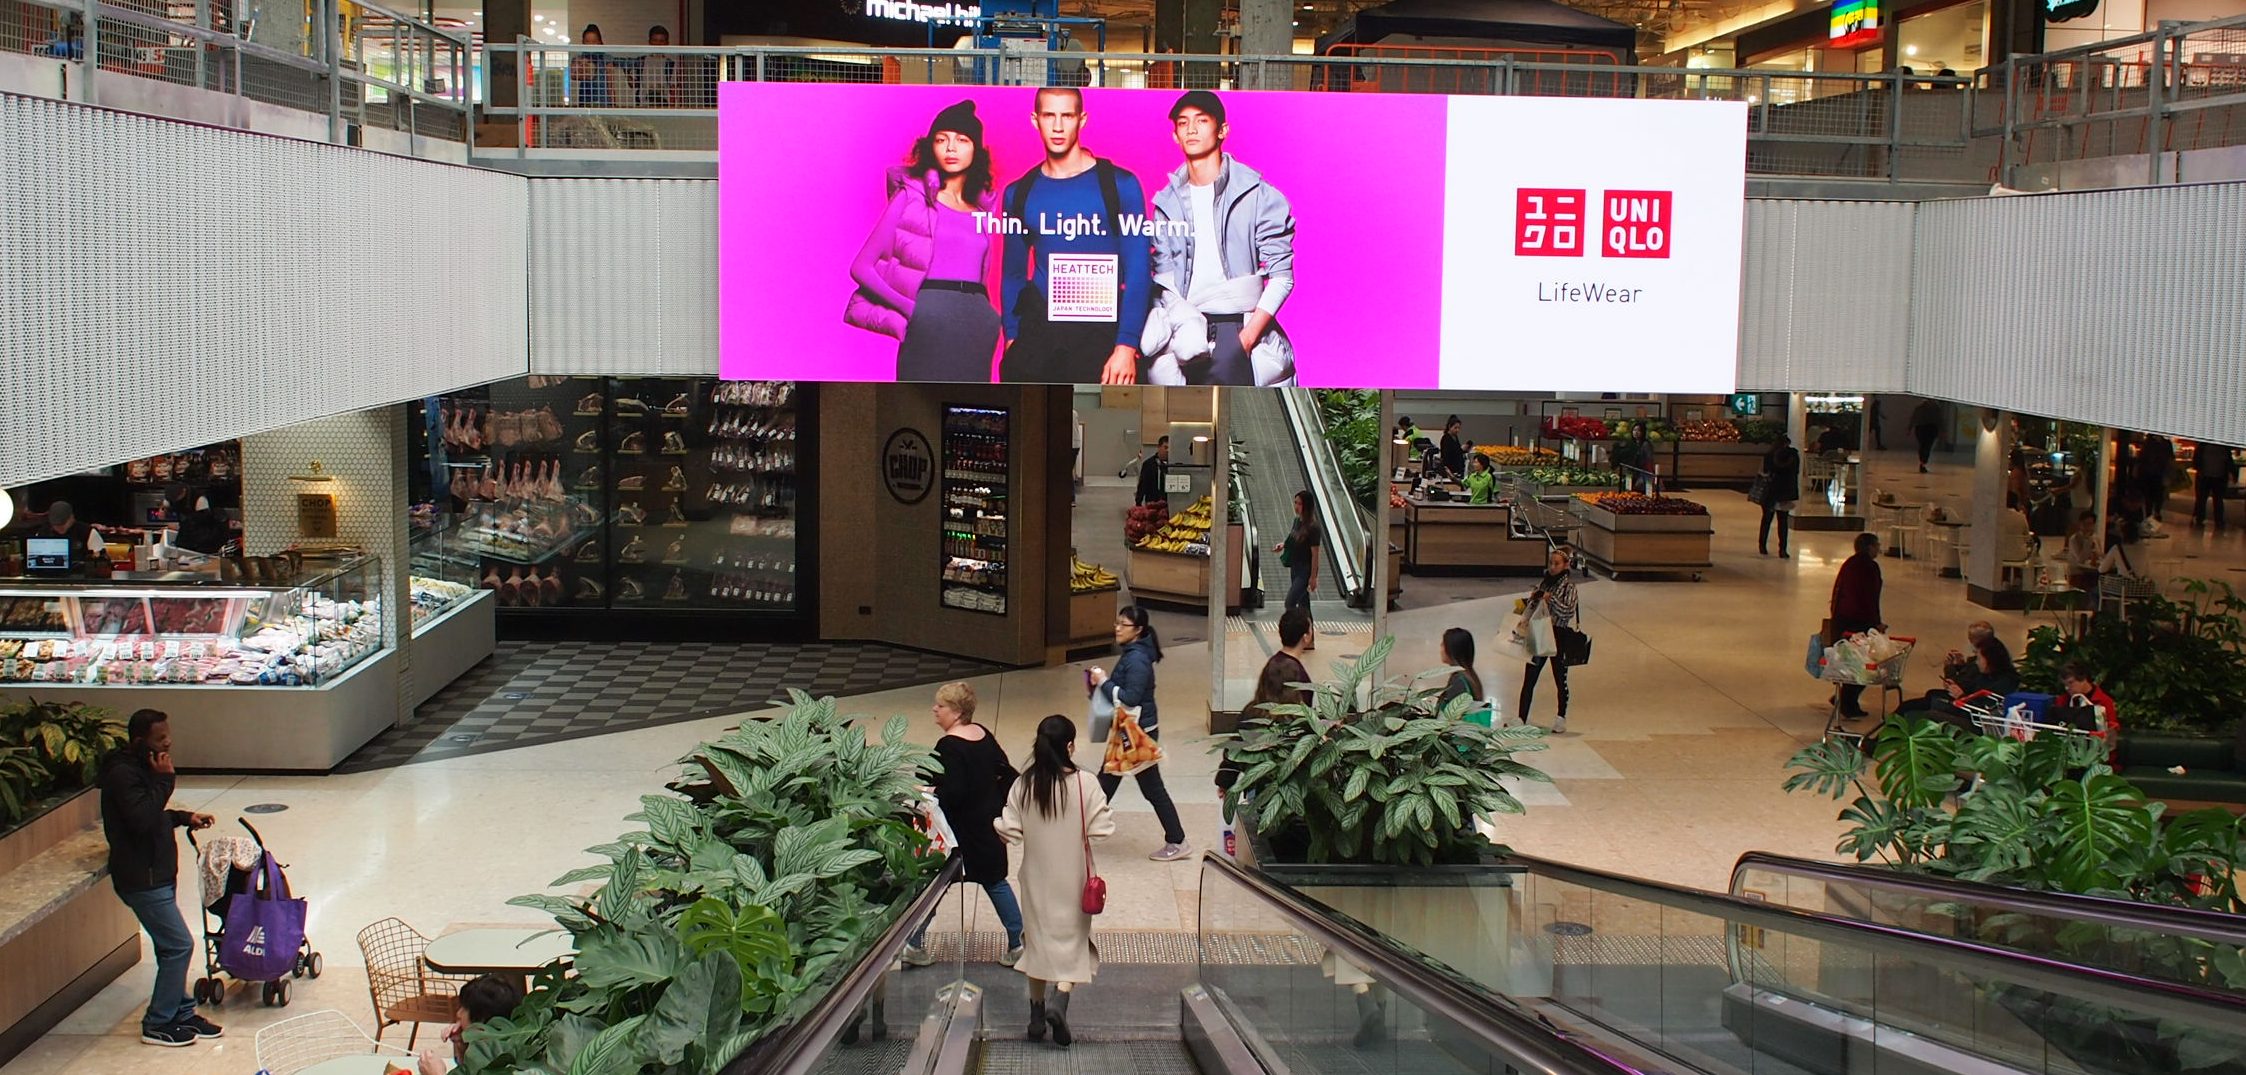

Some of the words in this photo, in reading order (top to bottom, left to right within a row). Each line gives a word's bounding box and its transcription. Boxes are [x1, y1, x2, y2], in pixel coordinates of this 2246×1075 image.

[866, 0, 952, 25] michael
[971, 212, 1029, 235] Thin.
[1040, 213, 1107, 241] Light.
[1118, 214, 1195, 238] Warm.
[1053, 264, 1114, 275] HEATTECH
[1538, 282, 1643, 303] LifeWear
[889, 454, 928, 481] CHOP
[302, 499, 331, 507] CHOP
[242, 944, 265, 957] ALDI
